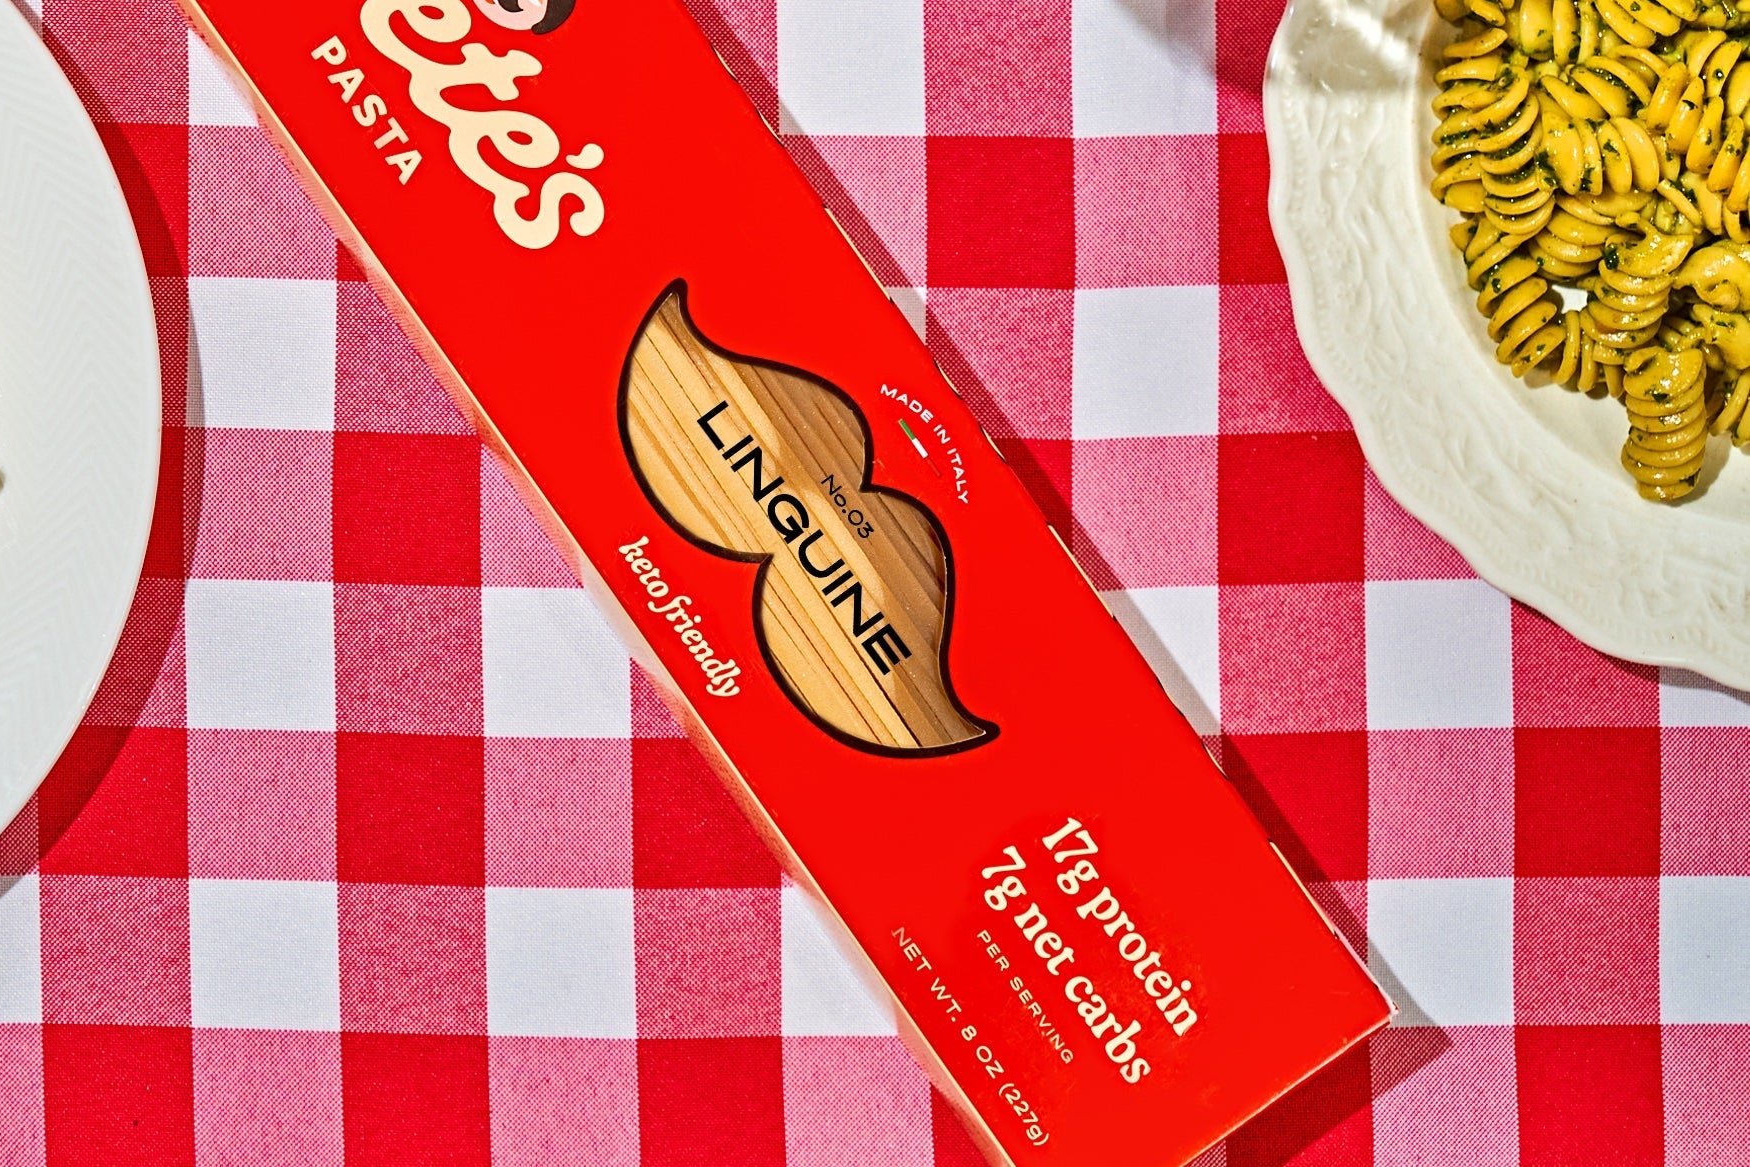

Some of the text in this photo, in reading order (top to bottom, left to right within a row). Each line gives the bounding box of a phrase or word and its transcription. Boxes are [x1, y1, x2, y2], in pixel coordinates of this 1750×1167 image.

[310, 35, 423, 186] PASTA
[696, 400, 912, 676] LINGUINE
[880, 383, 969, 504] MADE IN ITALY
[618, 535, 742, 697] keto friendly
[976, 929, 1074, 1065] PER SERVING
[981, 845, 1152, 1084] 7g net carbs
[1041, 817, 1198, 1037] 17g protein
[890, 926, 1050, 1147] NET WT. 8 OZ (227g)
